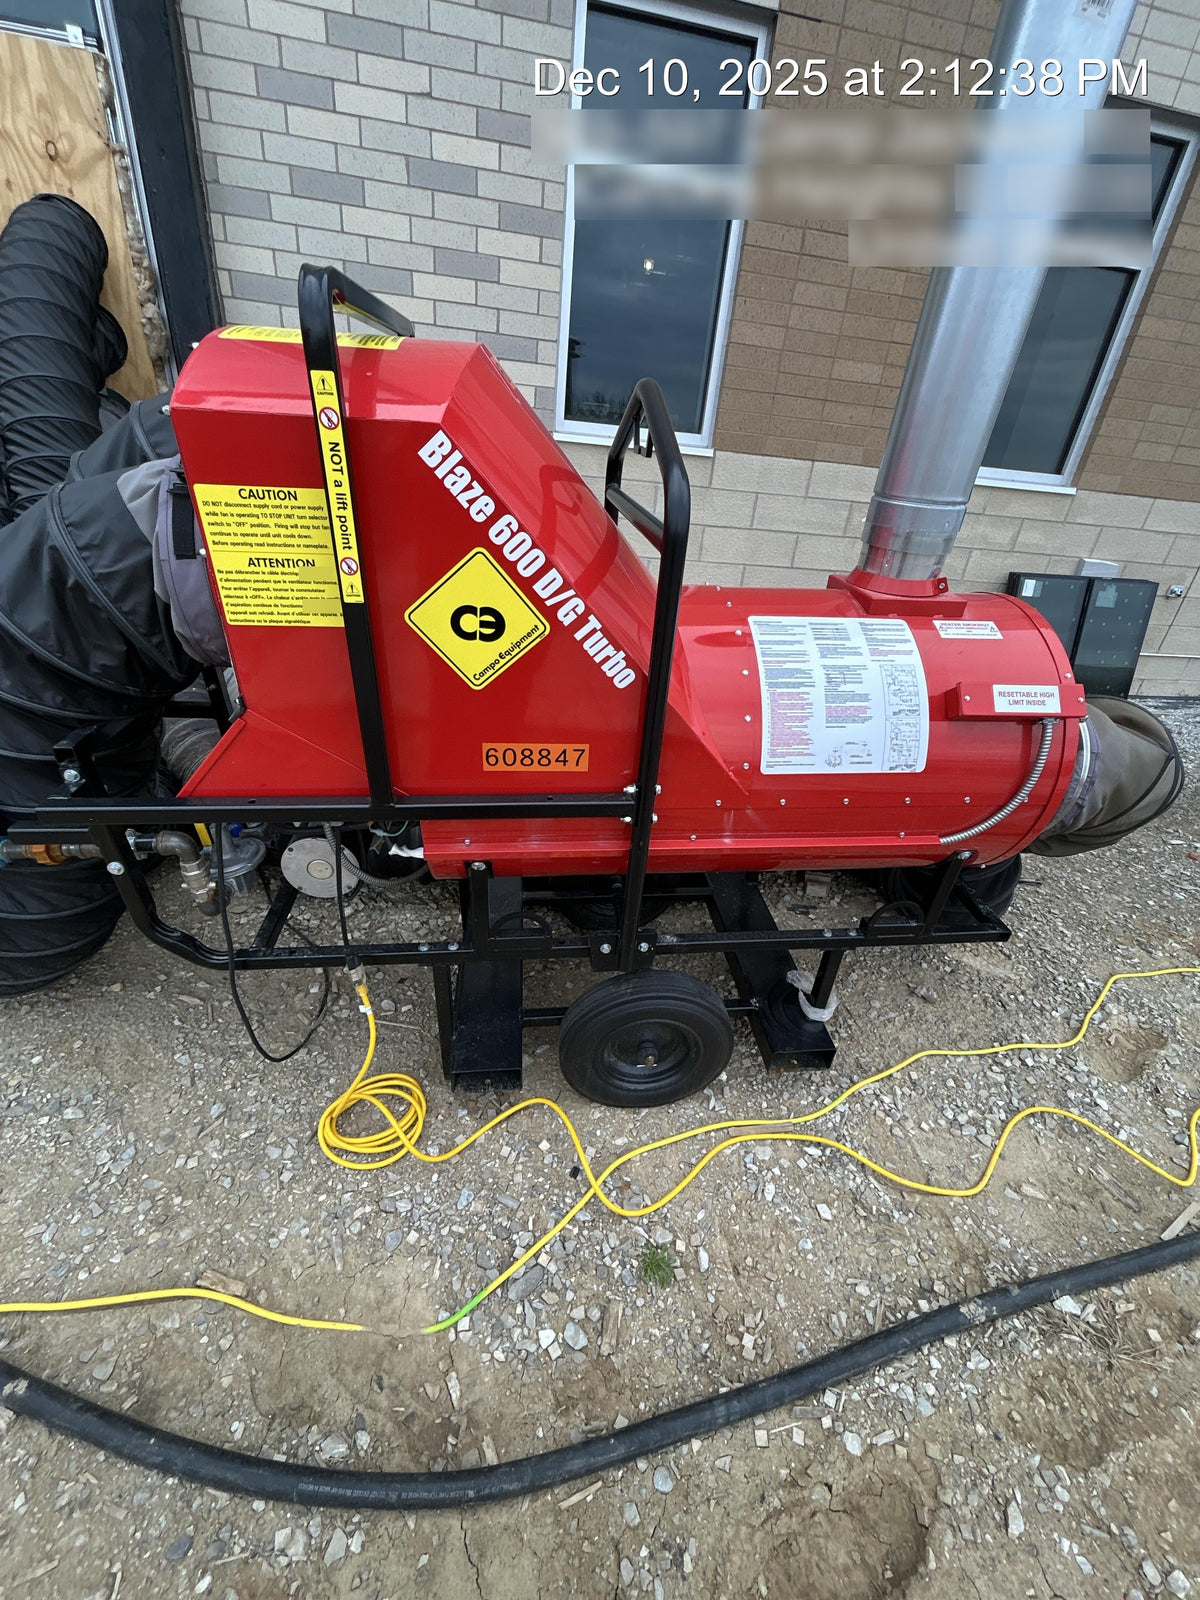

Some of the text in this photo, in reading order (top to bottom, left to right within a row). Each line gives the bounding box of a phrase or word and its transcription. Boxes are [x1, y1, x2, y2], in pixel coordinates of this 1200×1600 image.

[238, 488, 298, 501] CAUTION
[328, 441, 352, 550] NOT a lift point
[248, 557, 316, 568] ATTENTION
[417, 429, 637, 689] Blaze 600 D/G Turbo
[472, 624, 540, 681] Campo Equipment
[485, 747, 586, 767] 608847
